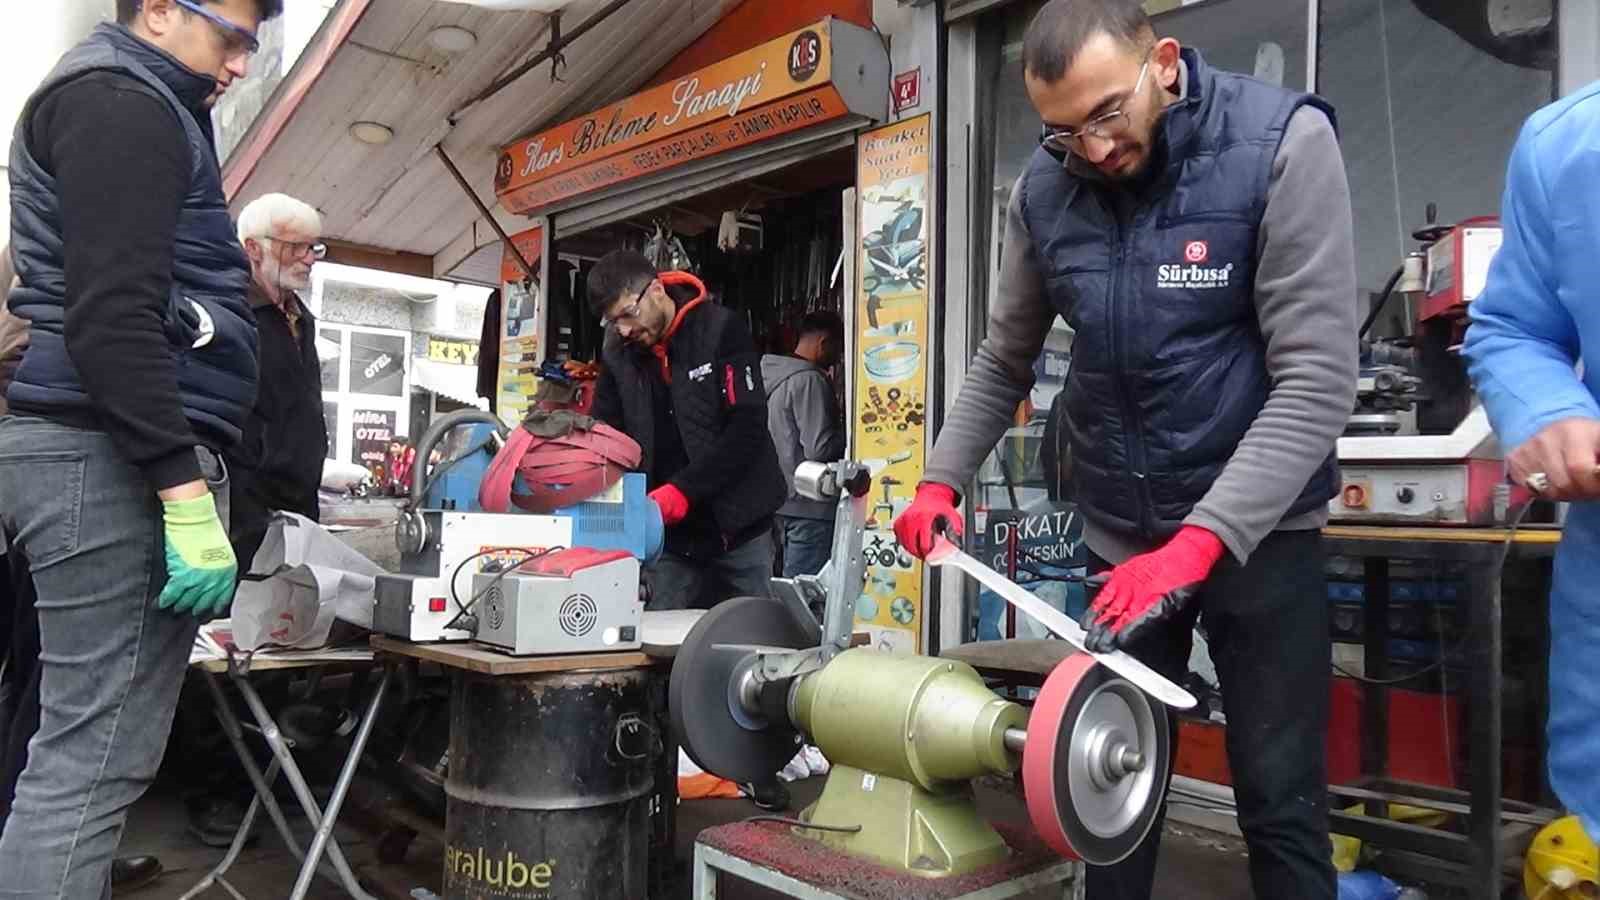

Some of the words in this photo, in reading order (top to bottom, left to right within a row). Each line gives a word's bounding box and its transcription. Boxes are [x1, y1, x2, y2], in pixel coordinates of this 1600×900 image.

[520, 137, 564, 176] Kars
[568, 107, 657, 158] Bileme
[663, 62, 765, 126] Sanayi
[430, 340, 480, 365] KEY
[363, 353, 392, 379] OTEL
[356, 428, 391, 441] OTEL
